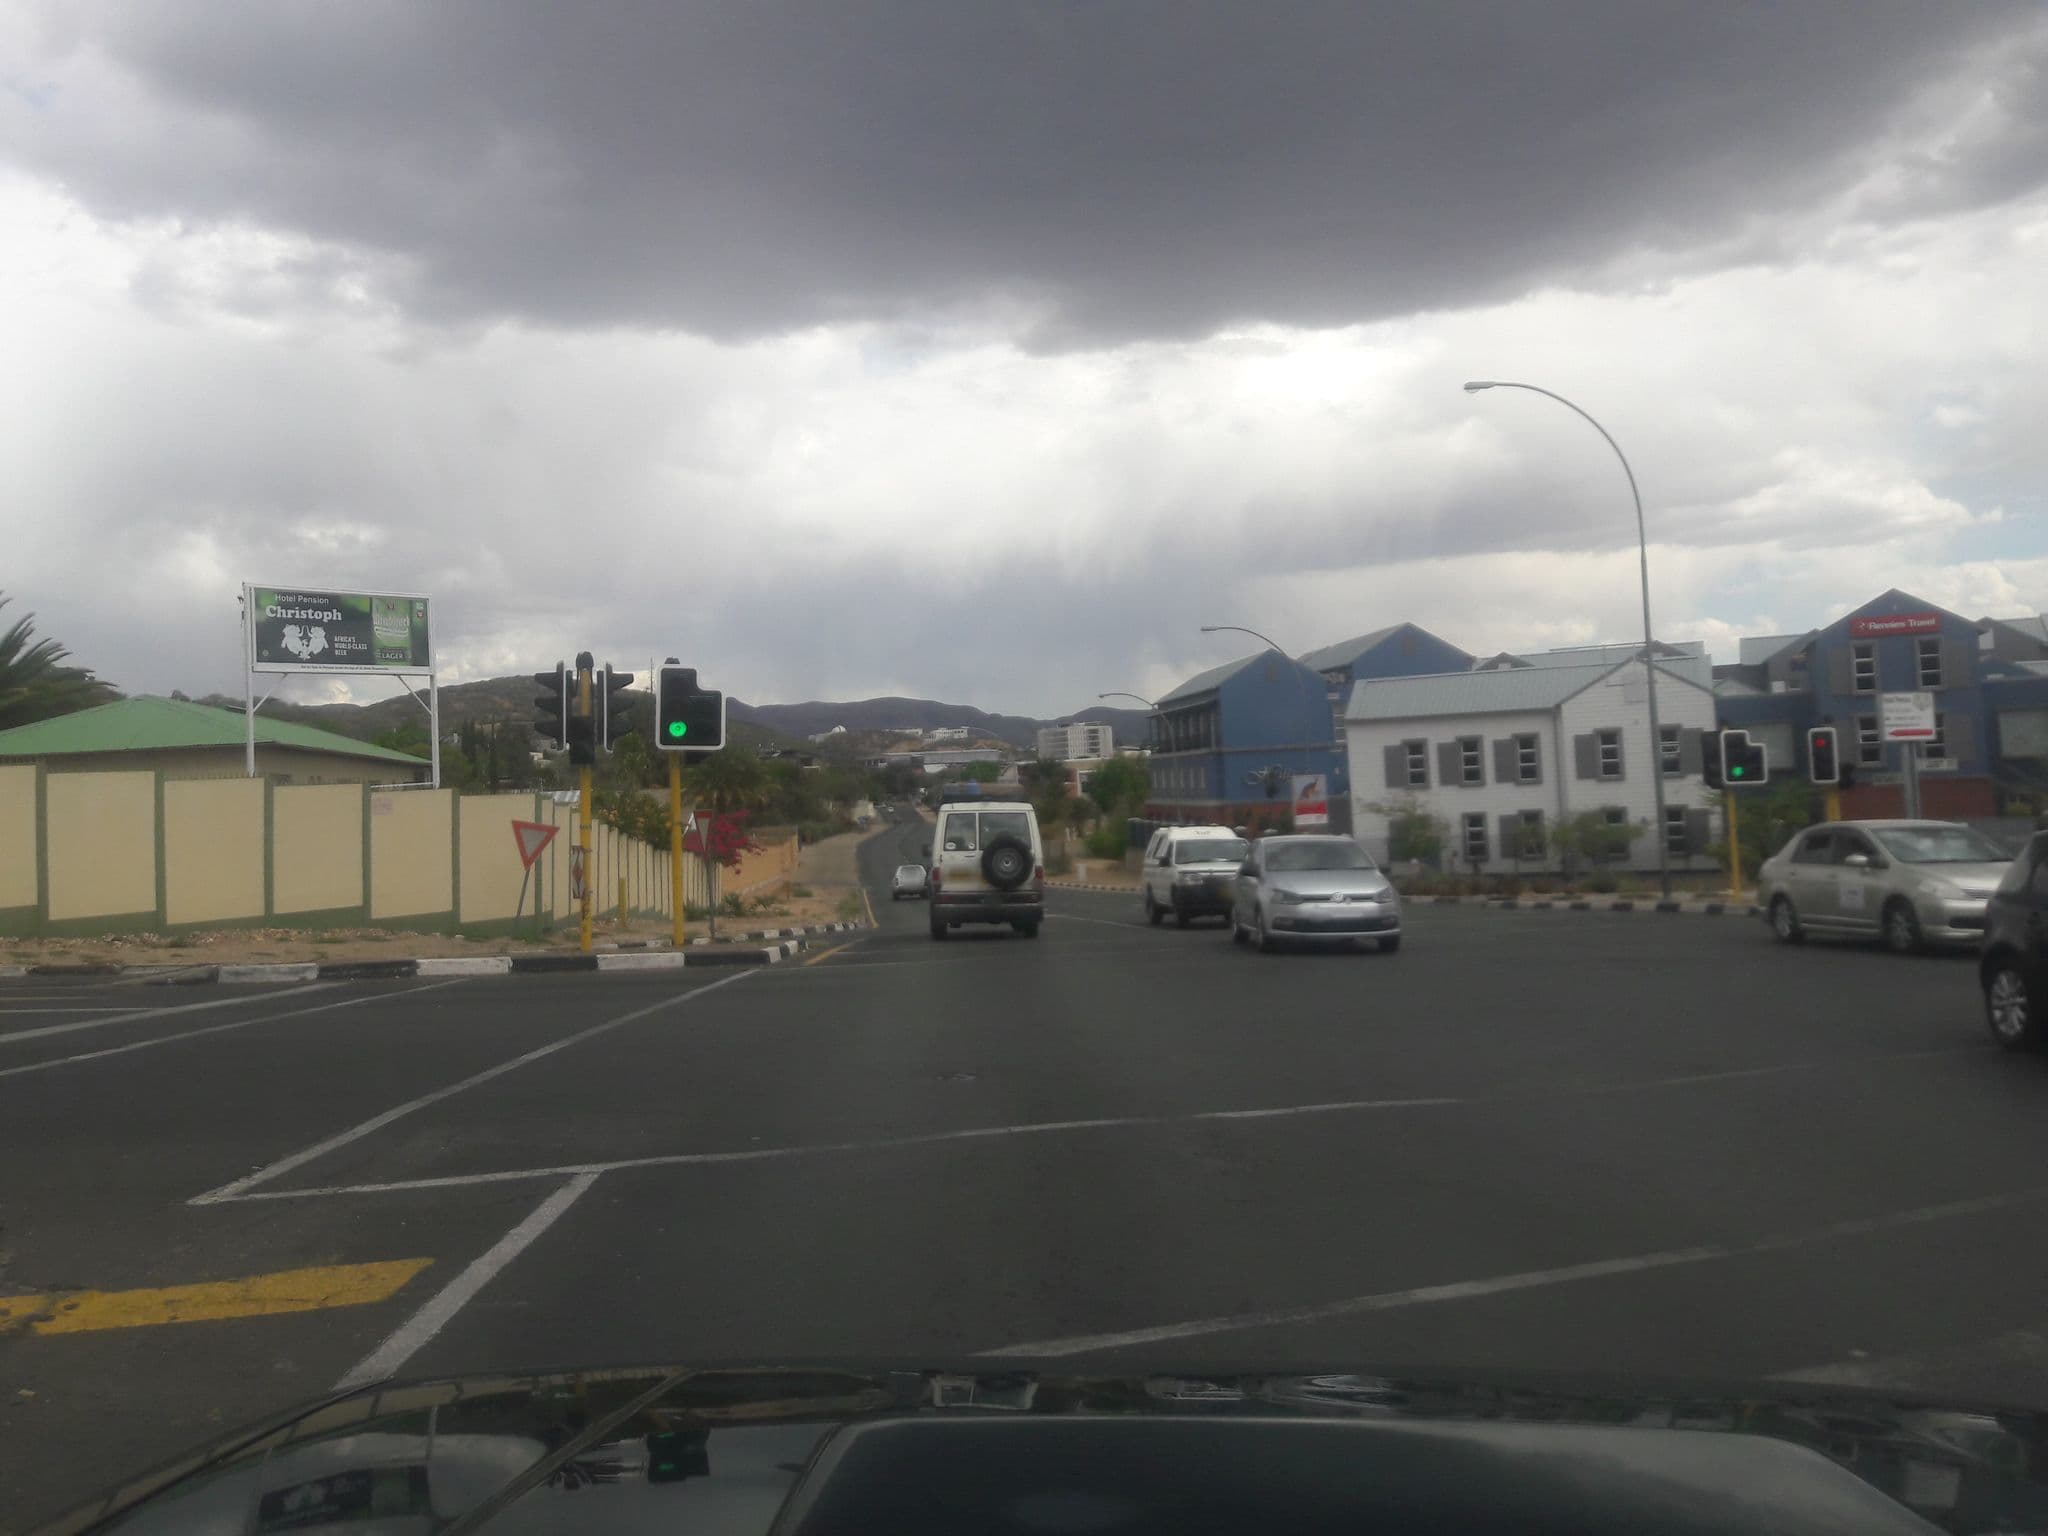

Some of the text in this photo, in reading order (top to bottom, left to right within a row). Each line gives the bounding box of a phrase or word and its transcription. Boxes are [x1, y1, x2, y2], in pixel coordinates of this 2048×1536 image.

[275, 594, 329, 604] Hotel Pension
[265, 604, 342, 623] Christoph
